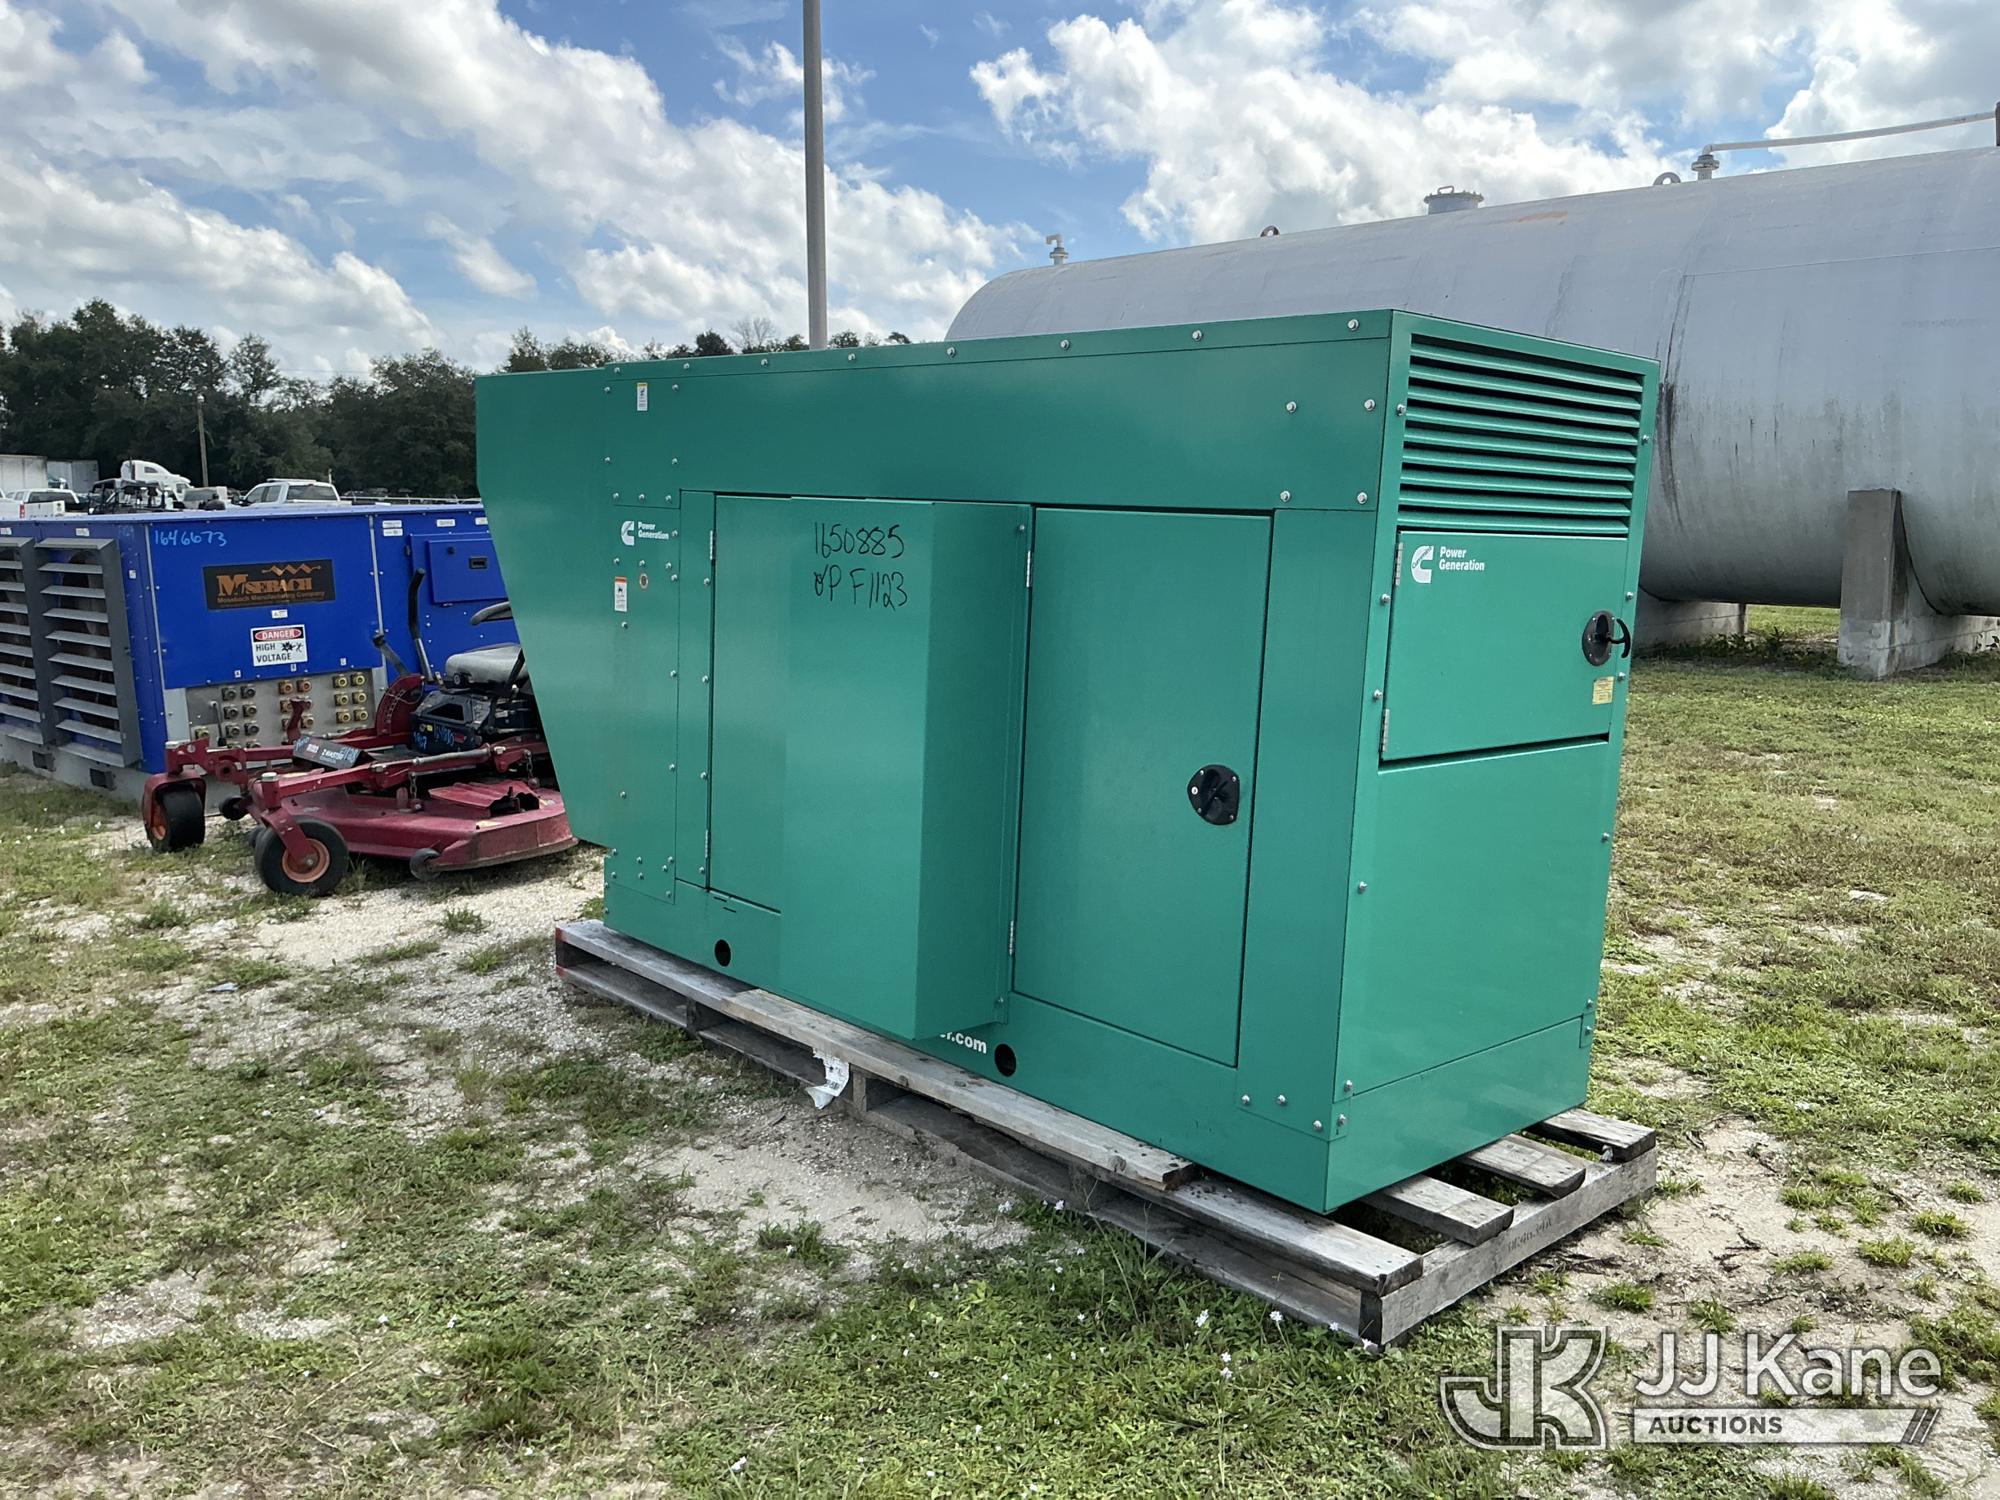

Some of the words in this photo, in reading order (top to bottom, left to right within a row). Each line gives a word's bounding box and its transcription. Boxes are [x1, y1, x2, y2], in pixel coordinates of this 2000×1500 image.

[638, 521, 656, 530] Power
[154, 529, 228, 547] 1646673
[638, 529, 669, 540] Generation
[814, 521, 905, 559] 1650885
[1440, 546, 1467, 558] Power
[1439, 558, 1485, 571] Generation
[262, 628, 295, 640] DANGER
[255, 643, 276, 652] HIGH
[256, 653, 292, 663] VOLTAGE
